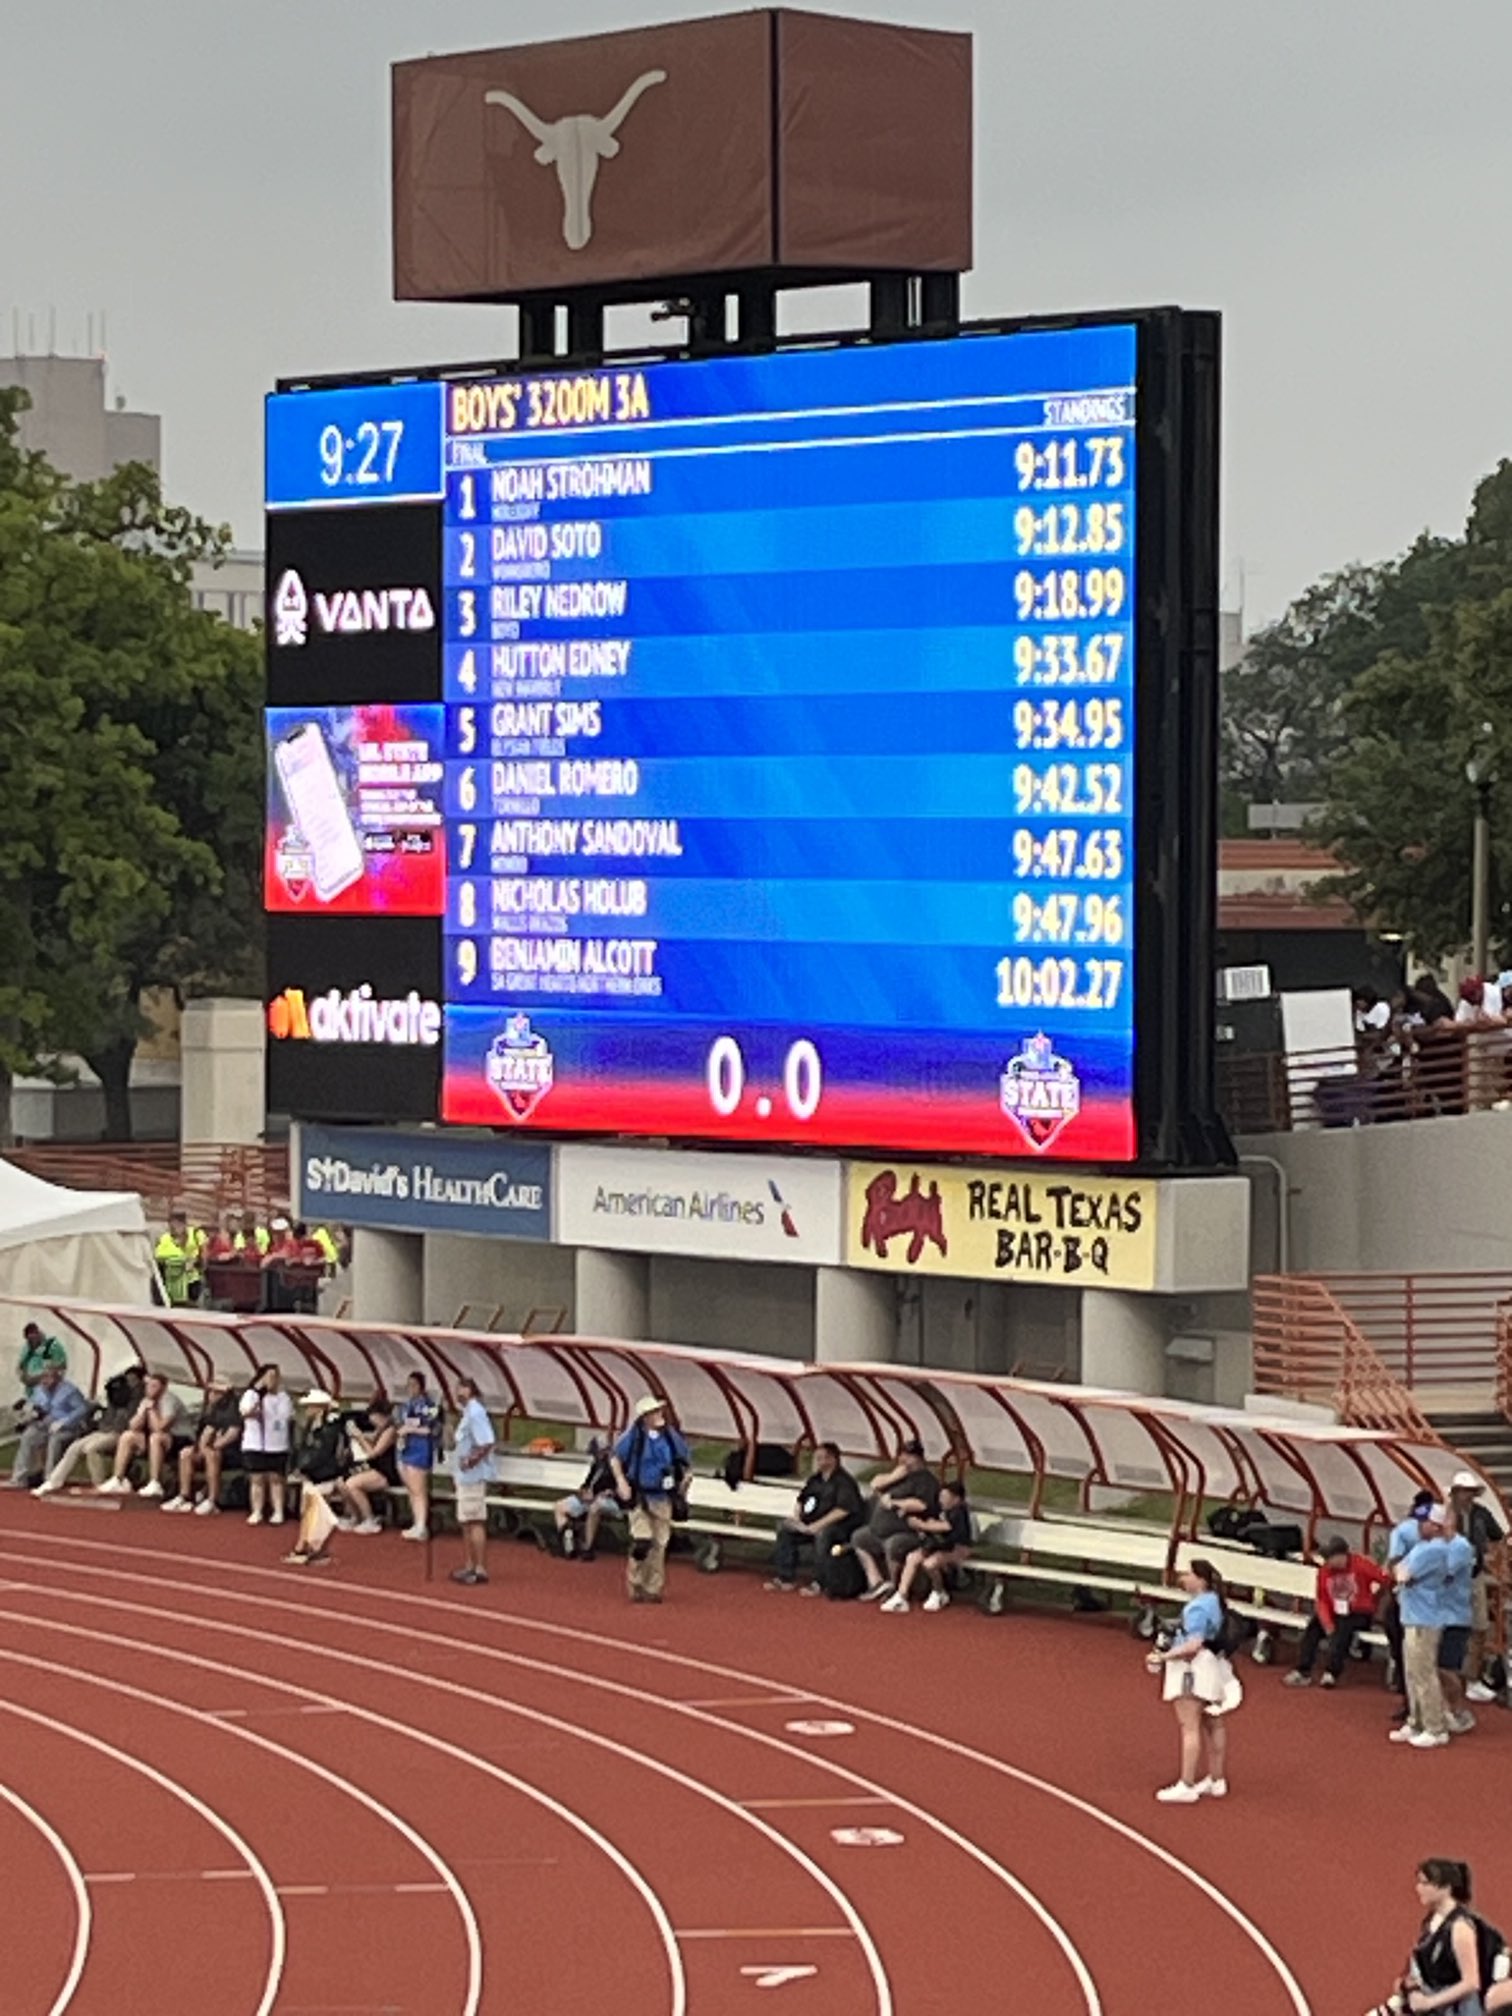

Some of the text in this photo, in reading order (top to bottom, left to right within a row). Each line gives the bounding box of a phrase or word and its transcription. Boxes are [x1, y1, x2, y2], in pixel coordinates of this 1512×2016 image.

[451, 372, 650, 432] BOYS' 3200M 3A
[319, 420, 404, 486] 9:27
[458, 475, 477, 520] 1
[492, 466, 544, 501] NOAH
[1014, 436, 1125, 491] 9:11.73
[459, 532, 476, 579] 2
[492, 526, 549, 561] DAVID
[551, 521, 602, 559] SOTO
[1014, 503, 1125, 556] 9:12.85
[314, 588, 435, 633] VANTA
[458, 590, 477, 637] 3
[491, 584, 543, 620] RILEY
[1014, 567, 1125, 621] 9:18.99
[457, 648, 477, 694] 4
[1013, 632, 1124, 686] 9:33.67
[458, 706, 477, 753] 5
[491, 701, 553, 737] GRANT
[555, 700, 602, 738] SIMS
[1013, 698, 1123, 750] 9:34.95
[458, 765, 477, 811] 6
[491, 759, 557, 796] DANIEL
[558, 758, 640, 797] ROMERO
[1012, 763, 1123, 815] 9:42.52
[458, 823, 477, 870] 7
[491, 818, 581, 856] ANTHONY
[1012, 828, 1123, 880] 9:47.63
[458, 880, 477, 929] 8
[491, 877, 581, 914] NICHOLAS
[1012, 891, 1124, 944] 9:47.96
[457, 938, 477, 987] 9
[491, 936, 581, 973] BENJAMIN
[582, 938, 658, 976] ALCOTT
[996, 956, 1124, 1010] 10:02.27
[310, 982, 442, 1045] aktivate
[1003, 1080, 1077, 1109] STATE
[593, 1184, 765, 1225] American Airlines
[967, 1179, 1142, 1233] REAL TEXAS
